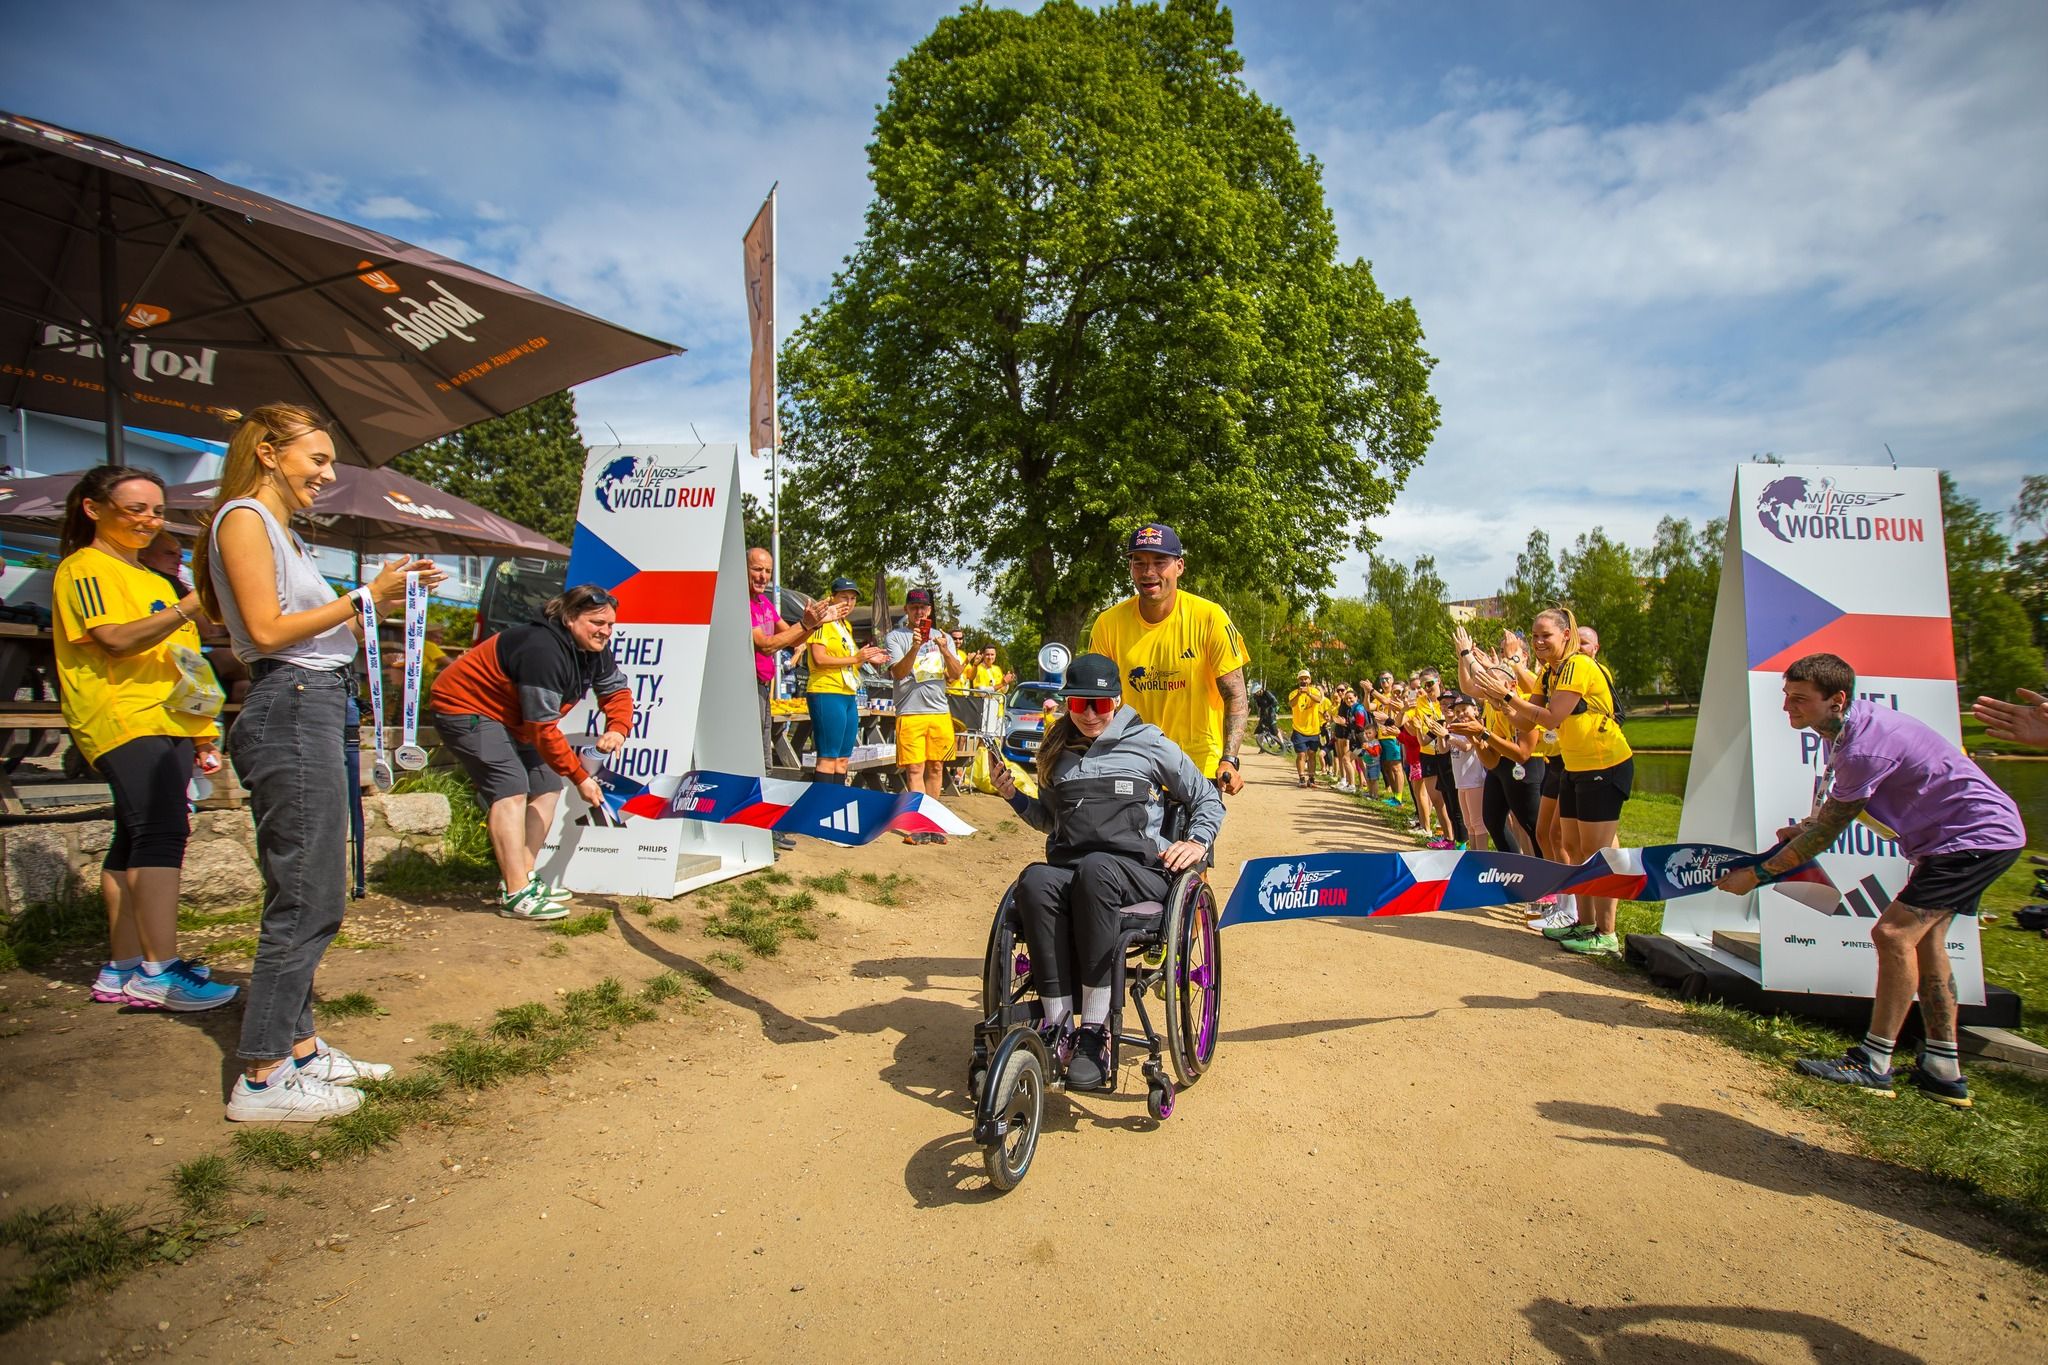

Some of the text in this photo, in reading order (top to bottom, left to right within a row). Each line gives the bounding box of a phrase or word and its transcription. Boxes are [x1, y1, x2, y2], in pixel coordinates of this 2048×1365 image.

[635, 468, 678, 478] WINGS
[638, 478, 664, 487] LIFE
[615, 487, 715, 508] WORLD RUN
[1807, 493, 1866, 504] WINGS
[1816, 505, 1849, 515] LIFE
[1785, 515, 1924, 542] WORLD RUN
[609, 631, 663, 666] ĚHEJ
[635, 674, 664, 707] TY,
[1139, 680, 1186, 691] WORLD RUN
[638, 845, 668, 853] PHILIPS
[1478, 868, 1524, 886] allwyn
[1274, 888, 1347, 911] WORLD RUN
[1784, 935, 1816, 947] allwyn
